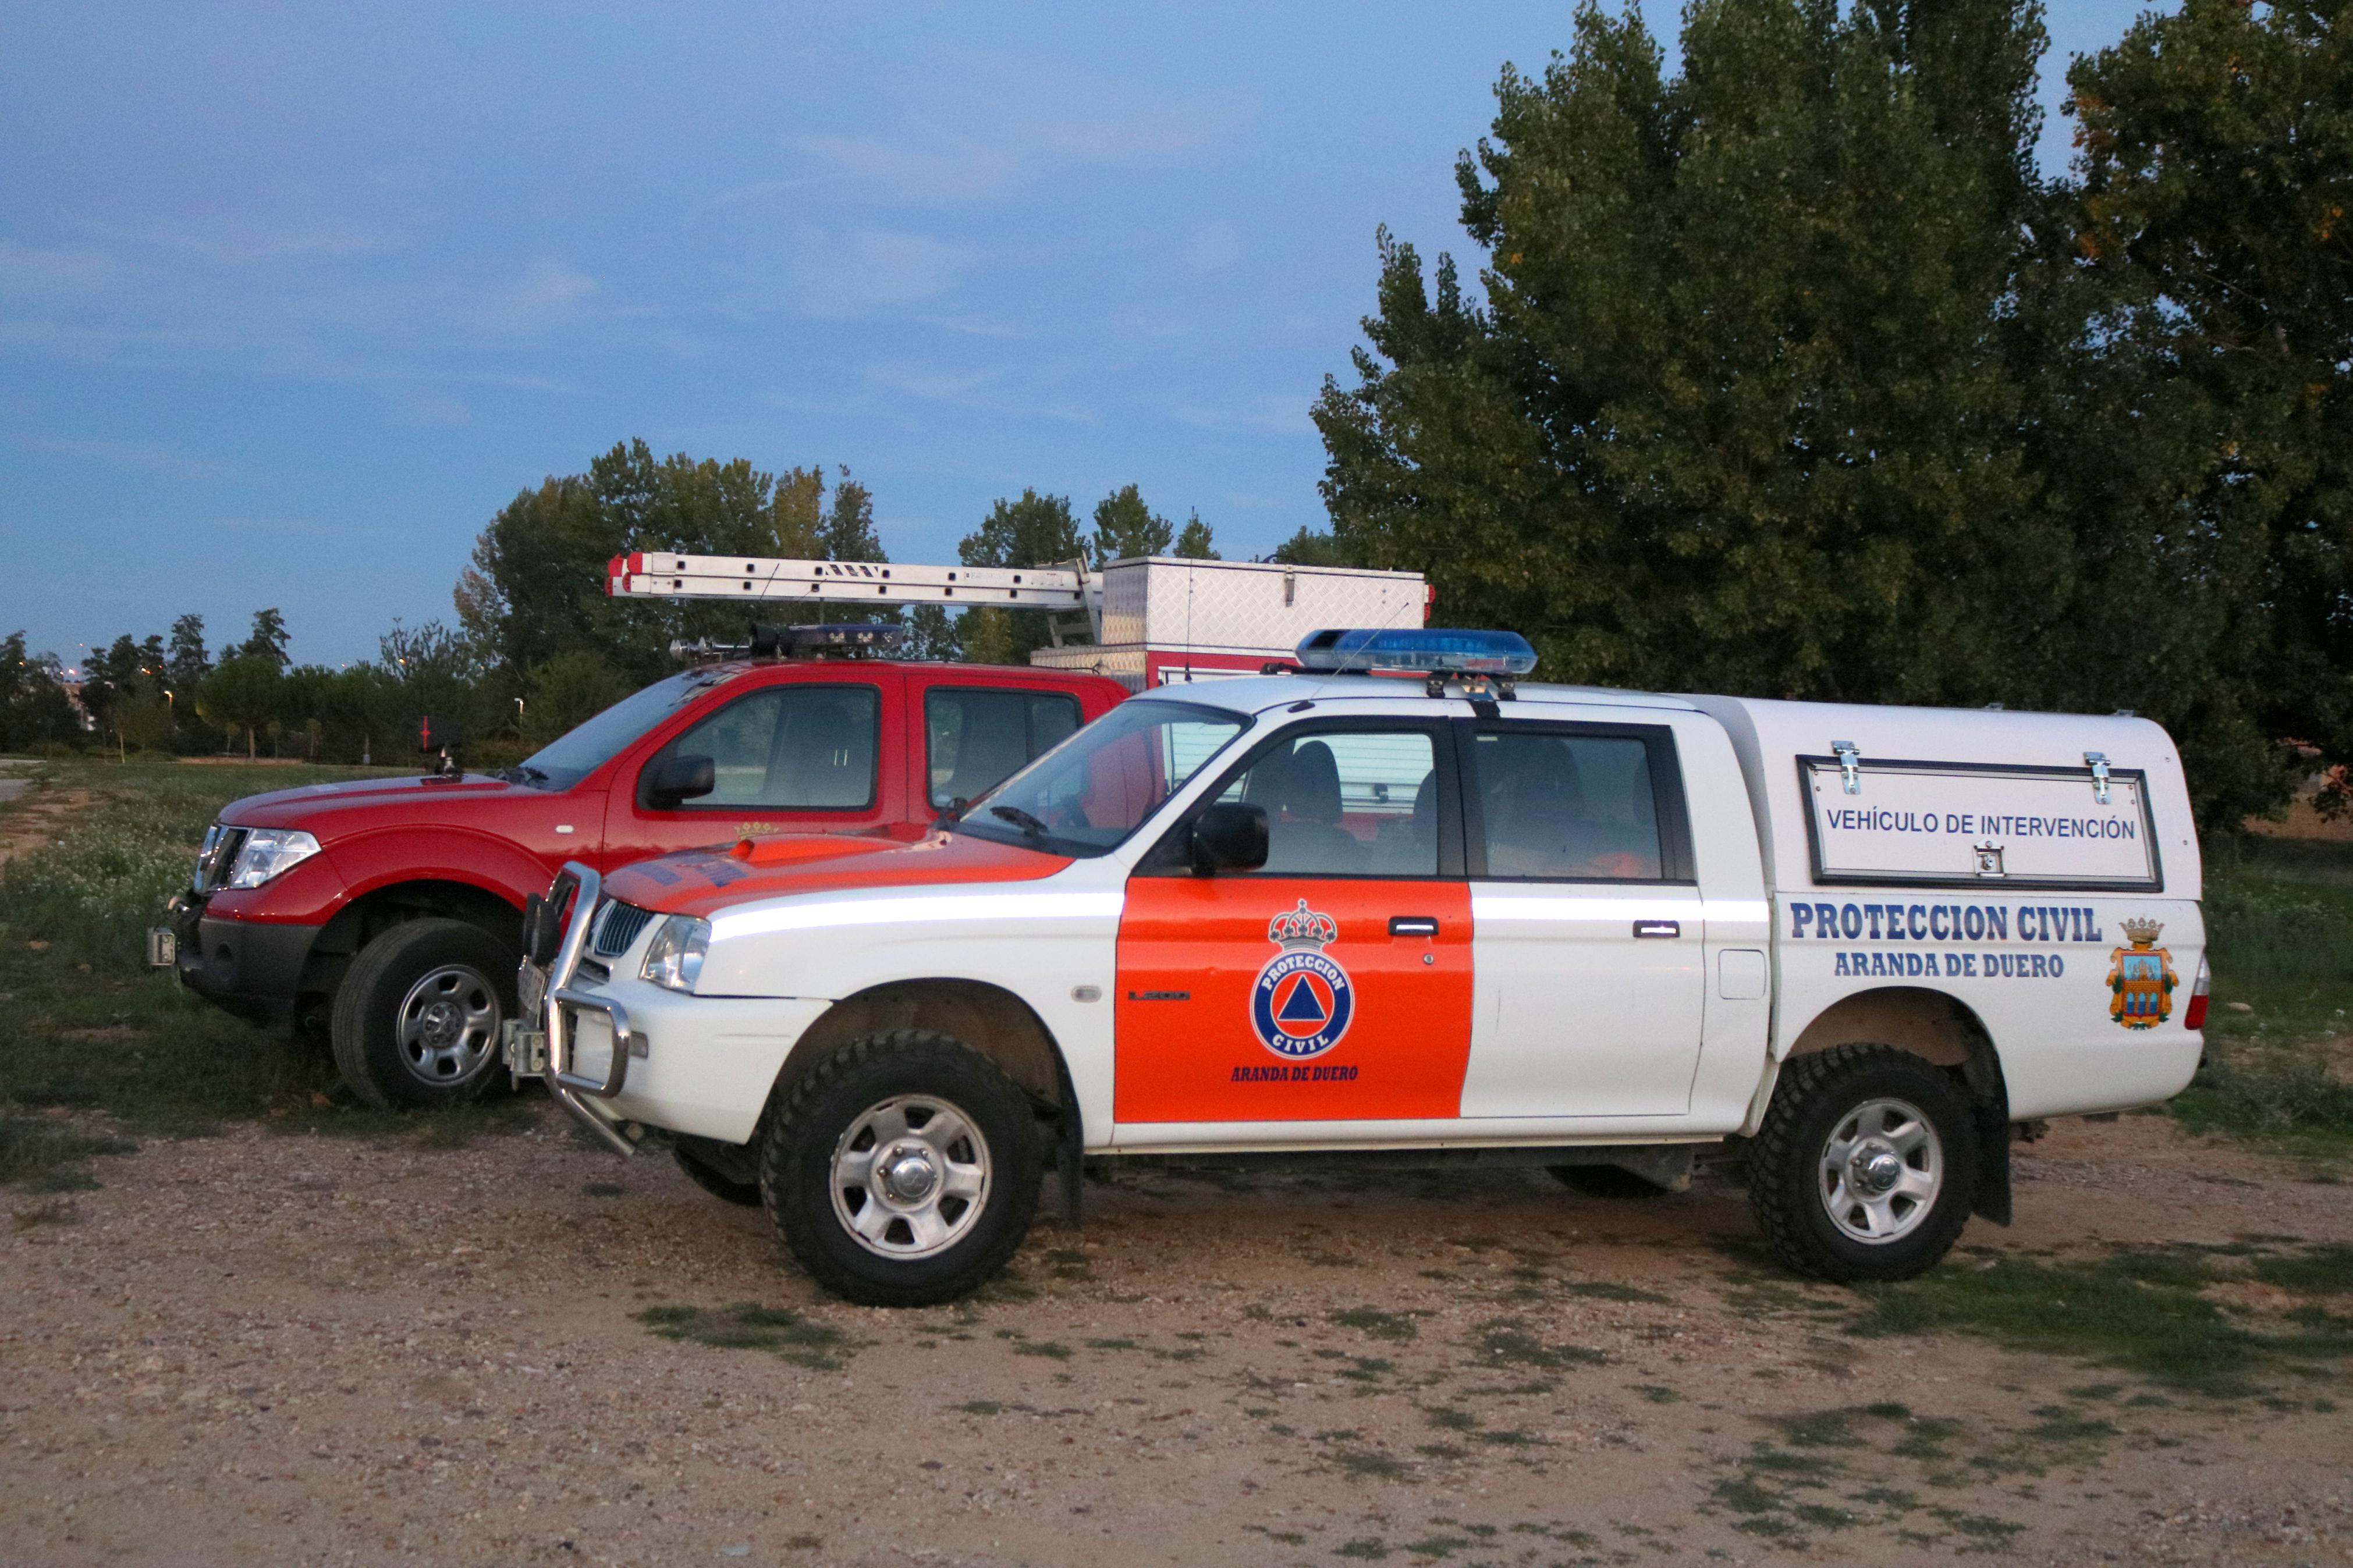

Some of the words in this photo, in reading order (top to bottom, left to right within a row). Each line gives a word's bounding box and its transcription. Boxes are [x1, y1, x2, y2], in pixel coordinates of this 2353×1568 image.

[1827, 806, 1938, 833] VEHÍCULO
[1946, 814, 1974, 834] DE
[1981, 815, 2134, 839] INTERVENCIÓN
[1790, 902, 2007, 940] PROTECCION
[2017, 906, 2102, 941] CIVIL
[1261, 955, 1346, 991] PROTECCION
[1834, 952, 1940, 976] ARANDA
[1944, 953, 1976, 977] DE
[1983, 954, 2064, 977] DUERO
[1272, 1034, 1329, 1053] CIVIL
[1230, 1067, 1289, 1082] ARANDA
[1291, 1066, 1311, 1081] DE
[1312, 1065, 1358, 1080] DUERO
